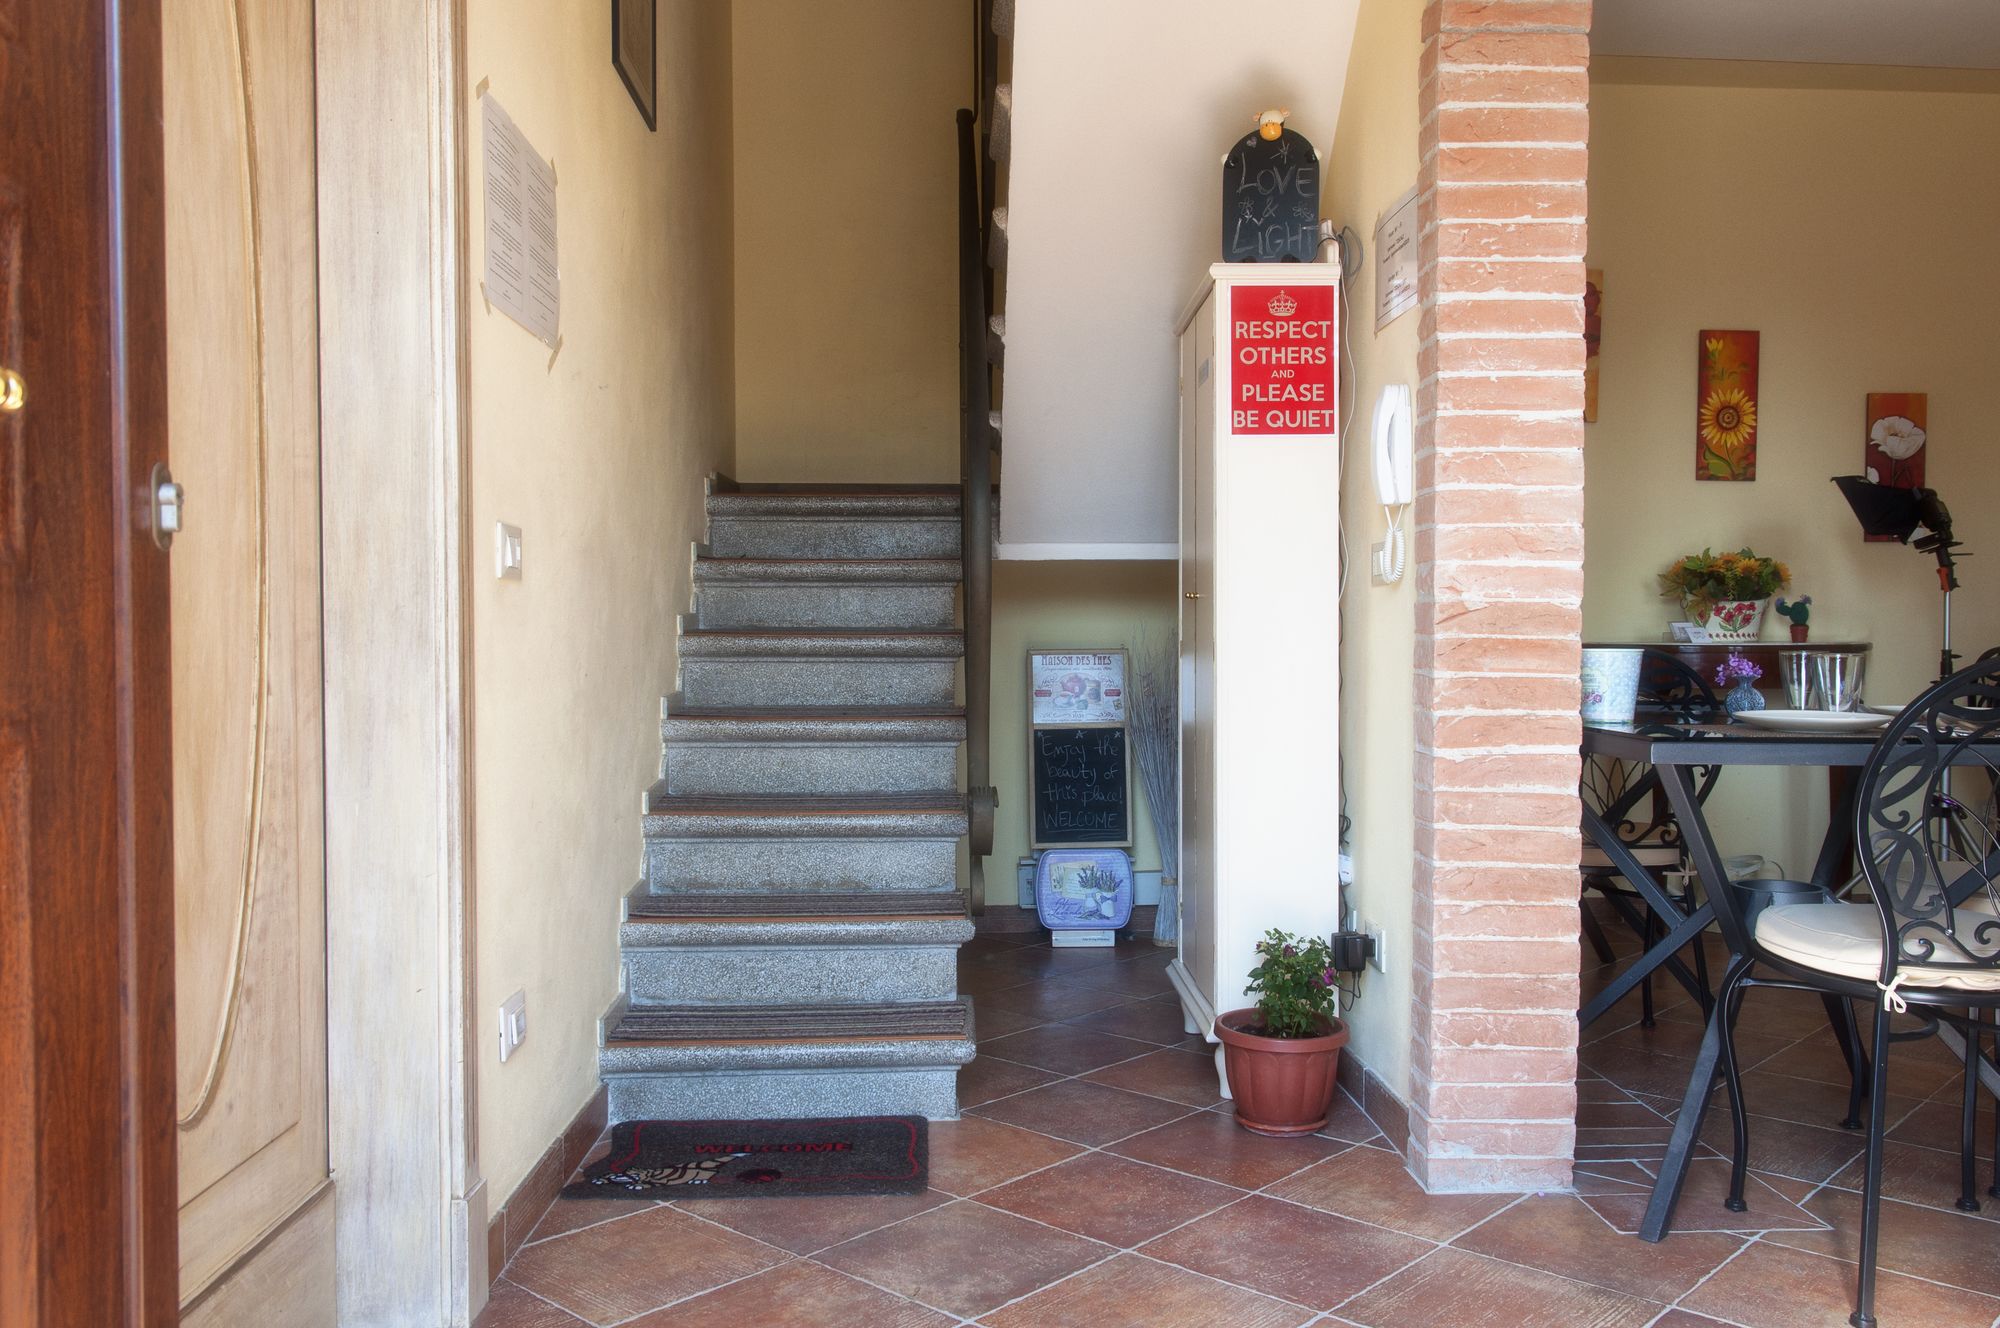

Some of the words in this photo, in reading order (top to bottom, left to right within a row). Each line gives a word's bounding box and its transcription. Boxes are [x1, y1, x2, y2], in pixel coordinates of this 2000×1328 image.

[1236, 152, 1315, 197] LOVE
[1263, 197, 1279, 217] &
[1232, 218, 1319, 258] LIGHT
[1235, 320, 1331, 339] RESPECT
[1239, 346, 1327, 365] OTHERS
[1271, 369, 1295, 379] AND
[1242, 383, 1325, 402] PLEASE
[1233, 409, 1259, 428] BE
[1265, 409, 1334, 428] QUIET
[1041, 654, 1073, 666] MAISON
[1076, 655, 1091, 666] DES
[1042, 735, 1086, 767] Enjoy
[1094, 734, 1119, 756] the
[1046, 758, 1097, 787] beauty
[1103, 762, 1119, 780] of
[1042, 783, 1078, 801] this
[1081, 785, 1122, 807] place!
[1043, 804, 1119, 829] WELCOME
[694, 1141, 853, 1153] WELCOME
